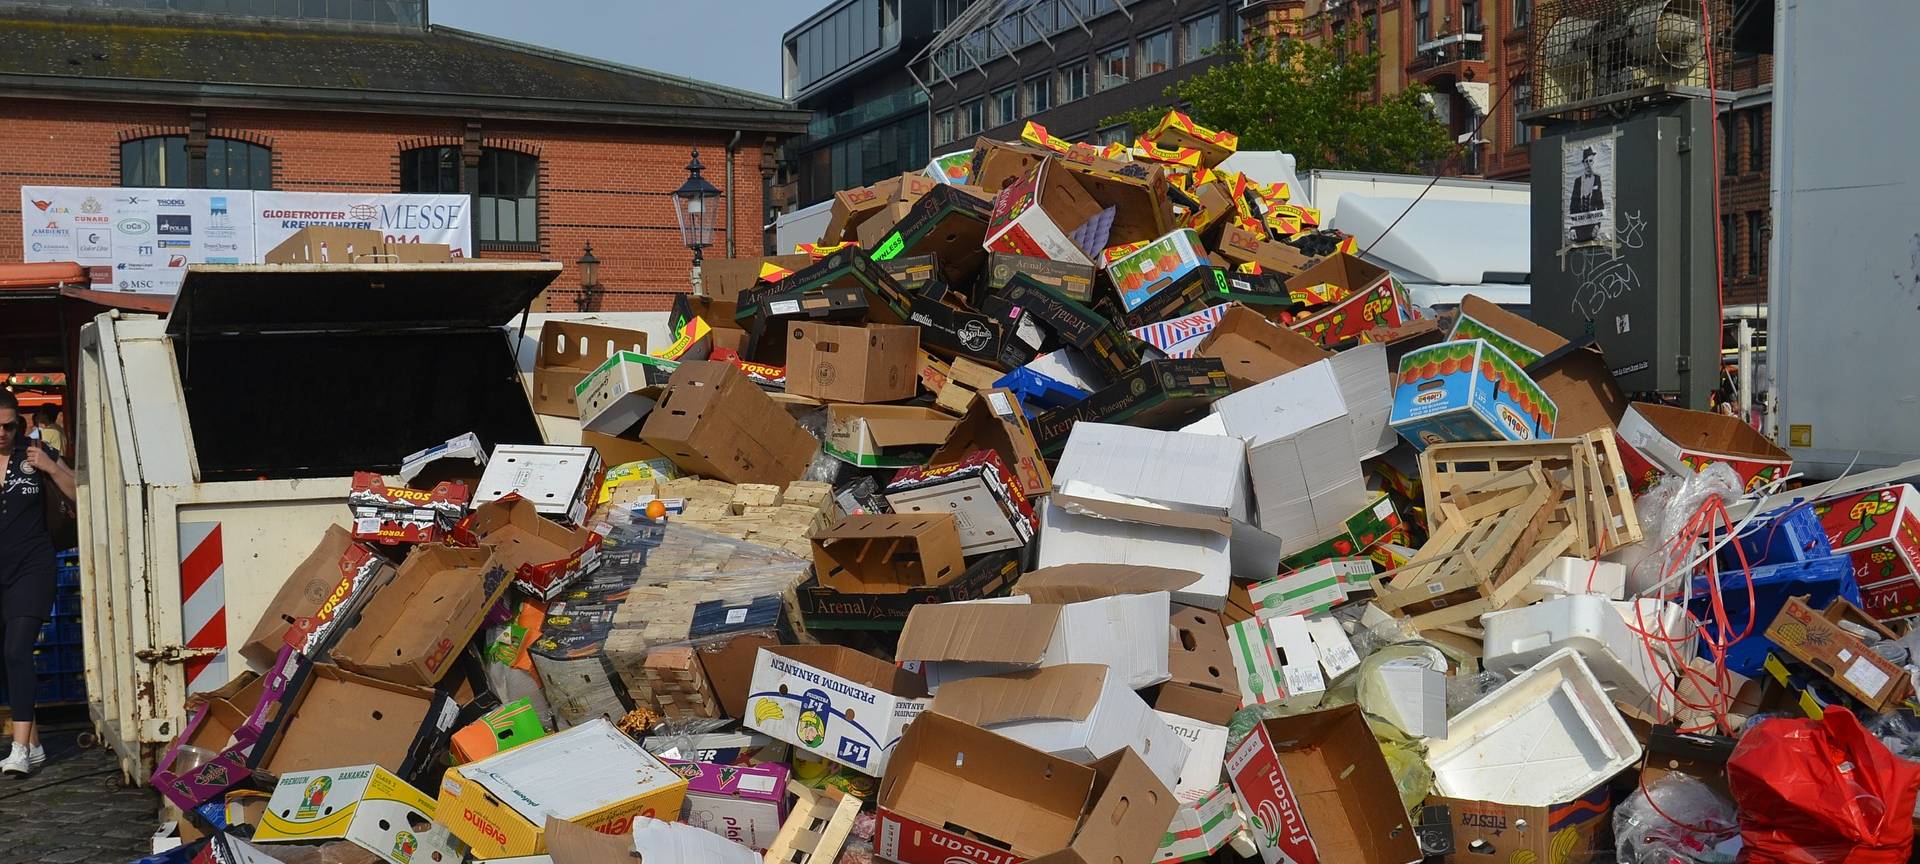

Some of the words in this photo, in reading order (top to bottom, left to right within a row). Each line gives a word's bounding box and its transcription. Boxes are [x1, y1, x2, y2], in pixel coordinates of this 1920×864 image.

[911, 179, 935, 193] Dol
[848, 190, 876, 204] Dole
[262, 210, 345, 220] GLOBETROTTER
[379, 204, 461, 230] MESSE
[1230, 231, 1260, 250] Dole
[139, 246, 153, 254] FTI
[662, 336, 691, 360] SHARON
[740, 363, 782, 377] TOROS
[1042, 407, 1083, 441] Arenal
[1099, 394, 1135, 417] Pineapple
[920, 464, 960, 478] TOROS
[386, 488, 432, 501] TOROS
[1007, 477, 1025, 504] TOROS
[632, 500, 648, 509] Sue
[317, 578, 350, 620] TOROS
[817, 598, 866, 616] Arenal
[1788, 603, 1812, 624] Dole
[425, 638, 454, 674] Dole
[771, 658, 822, 685] BANANEN
[822, 677, 876, 705] PREMIUM
[894, 709, 920, 718] REMIUM
[895, 702, 925, 710] BANANAS
[1167, 724, 1201, 742] frus
[279, 776, 310, 786] PREMIUM
[338, 770, 371, 781] BANANAS
[463, 808, 507, 846] evelina
[722, 816, 744, 843] plaf
[1461, 813, 1508, 830] FIESTA
